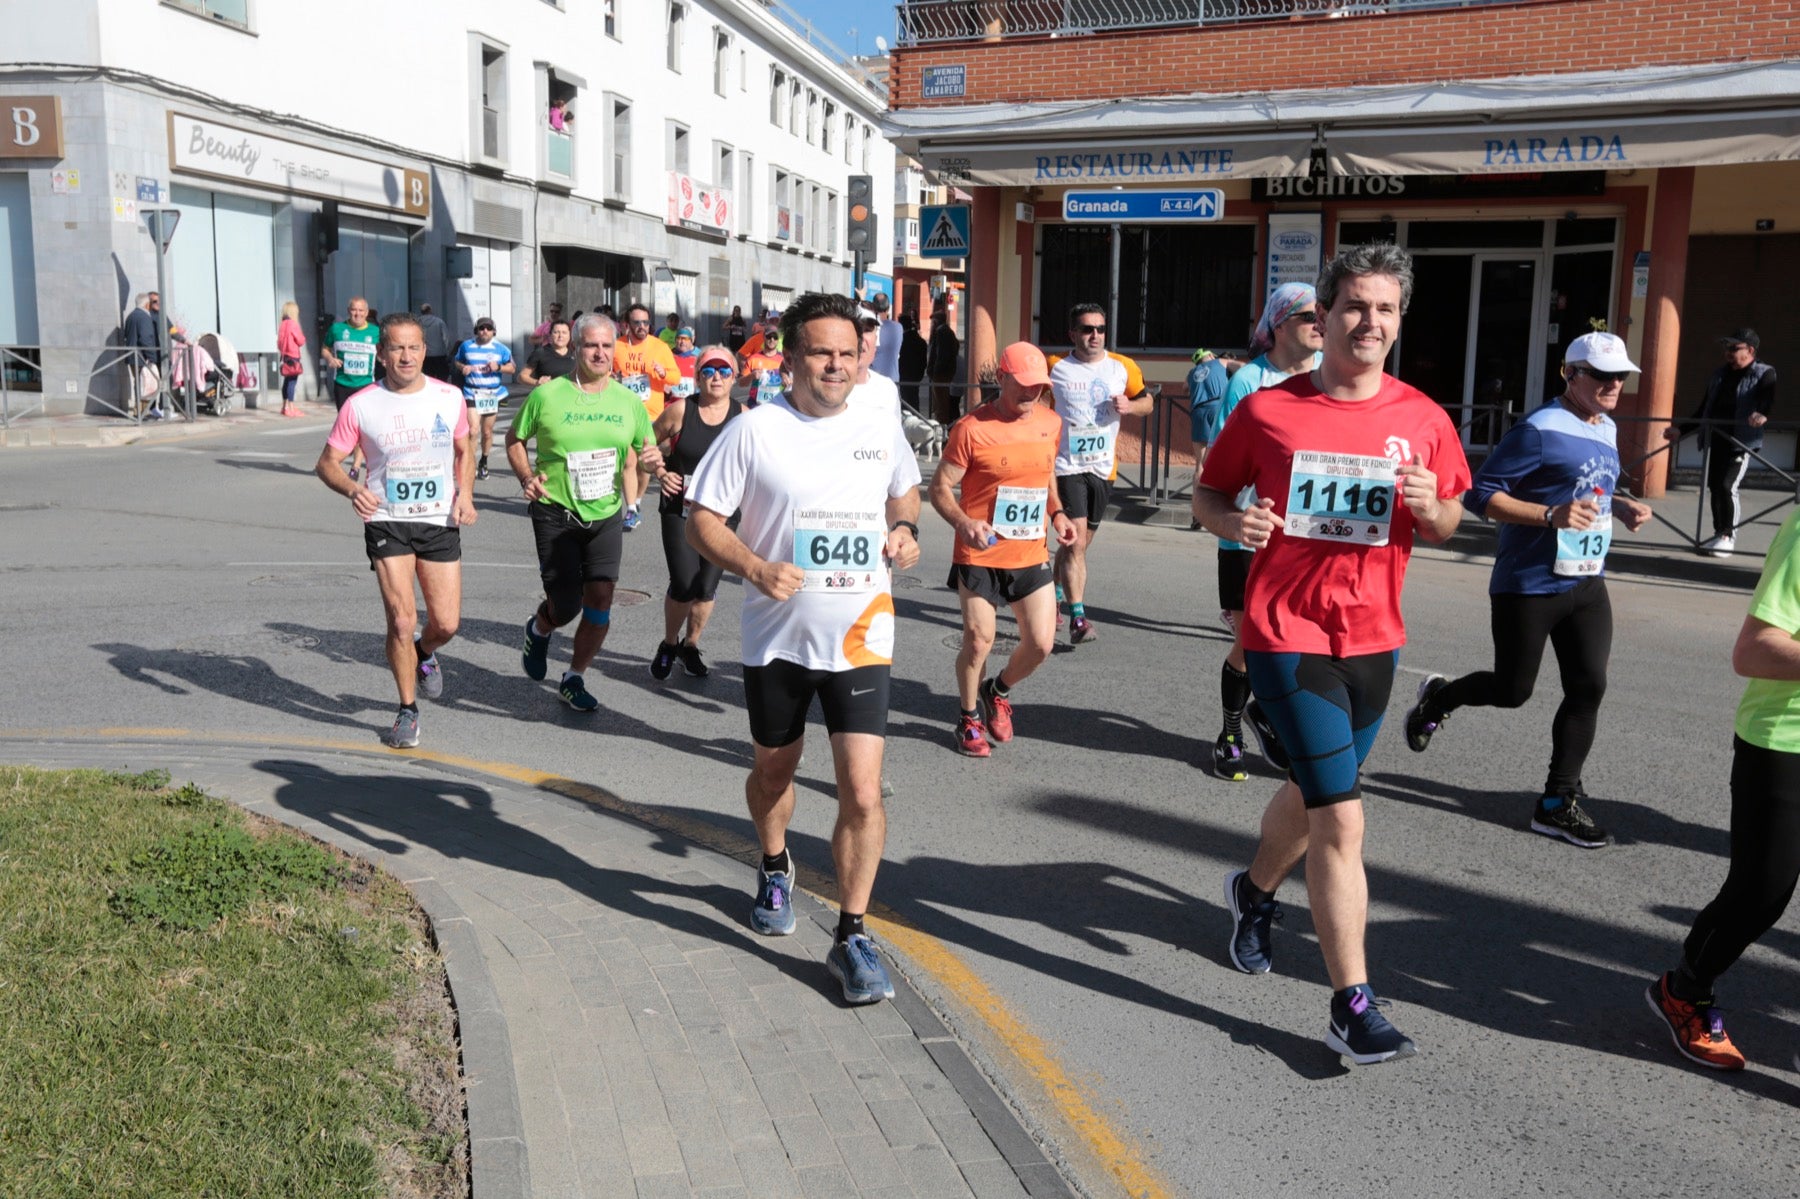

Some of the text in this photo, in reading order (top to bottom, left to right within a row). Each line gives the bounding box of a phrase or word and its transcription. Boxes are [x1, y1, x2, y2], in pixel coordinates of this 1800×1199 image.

[933, 67, 964, 76] AVENIDA
[935, 75, 961, 85] JACOBO
[925, 85, 964, 96] CAMARERO
[12, 107, 40, 146] B
[1484, 135, 1628, 165] PARADA
[189, 125, 261, 175] Beauty
[301, 164, 330, 180] SHOP
[411, 177, 424, 207] B
[1036, 149, 1234, 179] RESTAURANTE
[1266, 175, 1406, 196] BICHITOS
[1067, 199, 1129, 213] Granada
[348, 360, 365, 369] 690
[628, 353, 643, 361] WE
[628, 383, 646, 394] 36
[479, 399, 494, 408] 670
[1077, 436, 1105, 453] 270
[1320, 455, 1336, 464] GRAN
[1337, 456, 1361, 467] PREMIO
[1362, 458, 1369, 468] DE
[1370, 459, 1392, 469] FONDO
[396, 480, 437, 501] 979
[1298, 478, 1389, 517] 1116
[818, 511, 833, 519] GRAN
[835, 512, 853, 520] PREMIO
[855, 512, 861, 520] DE
[1005, 503, 1040, 523] 614
[810, 535, 869, 566] 648
[1579, 534, 1603, 556] 13
